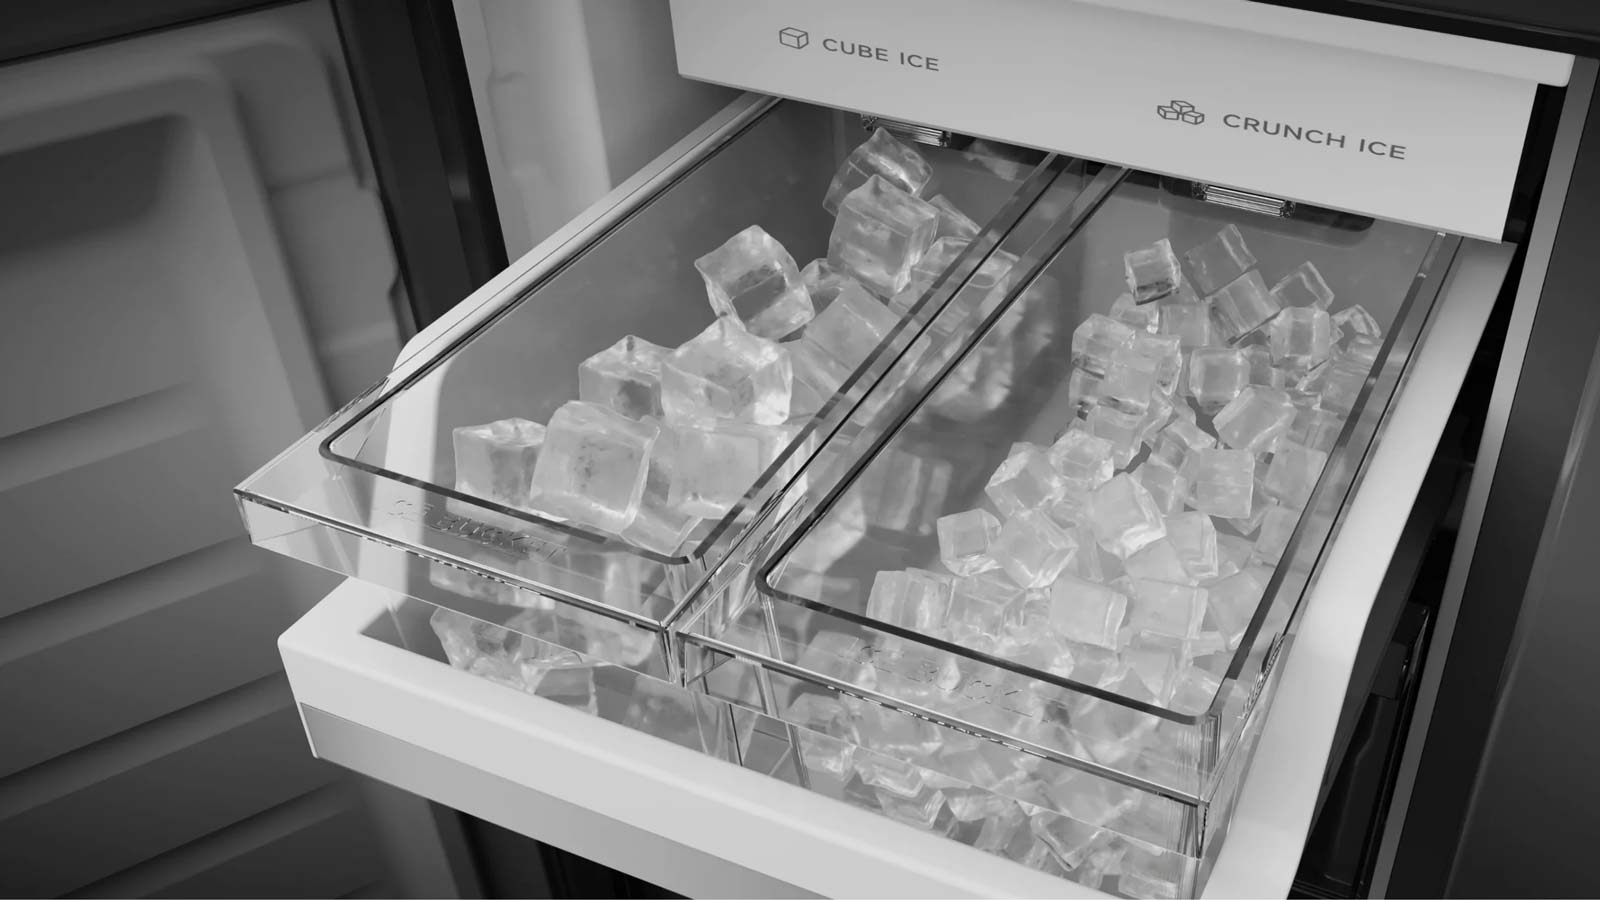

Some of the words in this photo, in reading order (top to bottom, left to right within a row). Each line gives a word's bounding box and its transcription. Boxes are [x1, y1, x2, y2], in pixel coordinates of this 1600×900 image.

[821, 38, 889, 62] CUBE
[900, 52, 940, 72] ICE
[1222, 113, 1346, 149] CRUNCH
[1359, 139, 1408, 160] ICE
